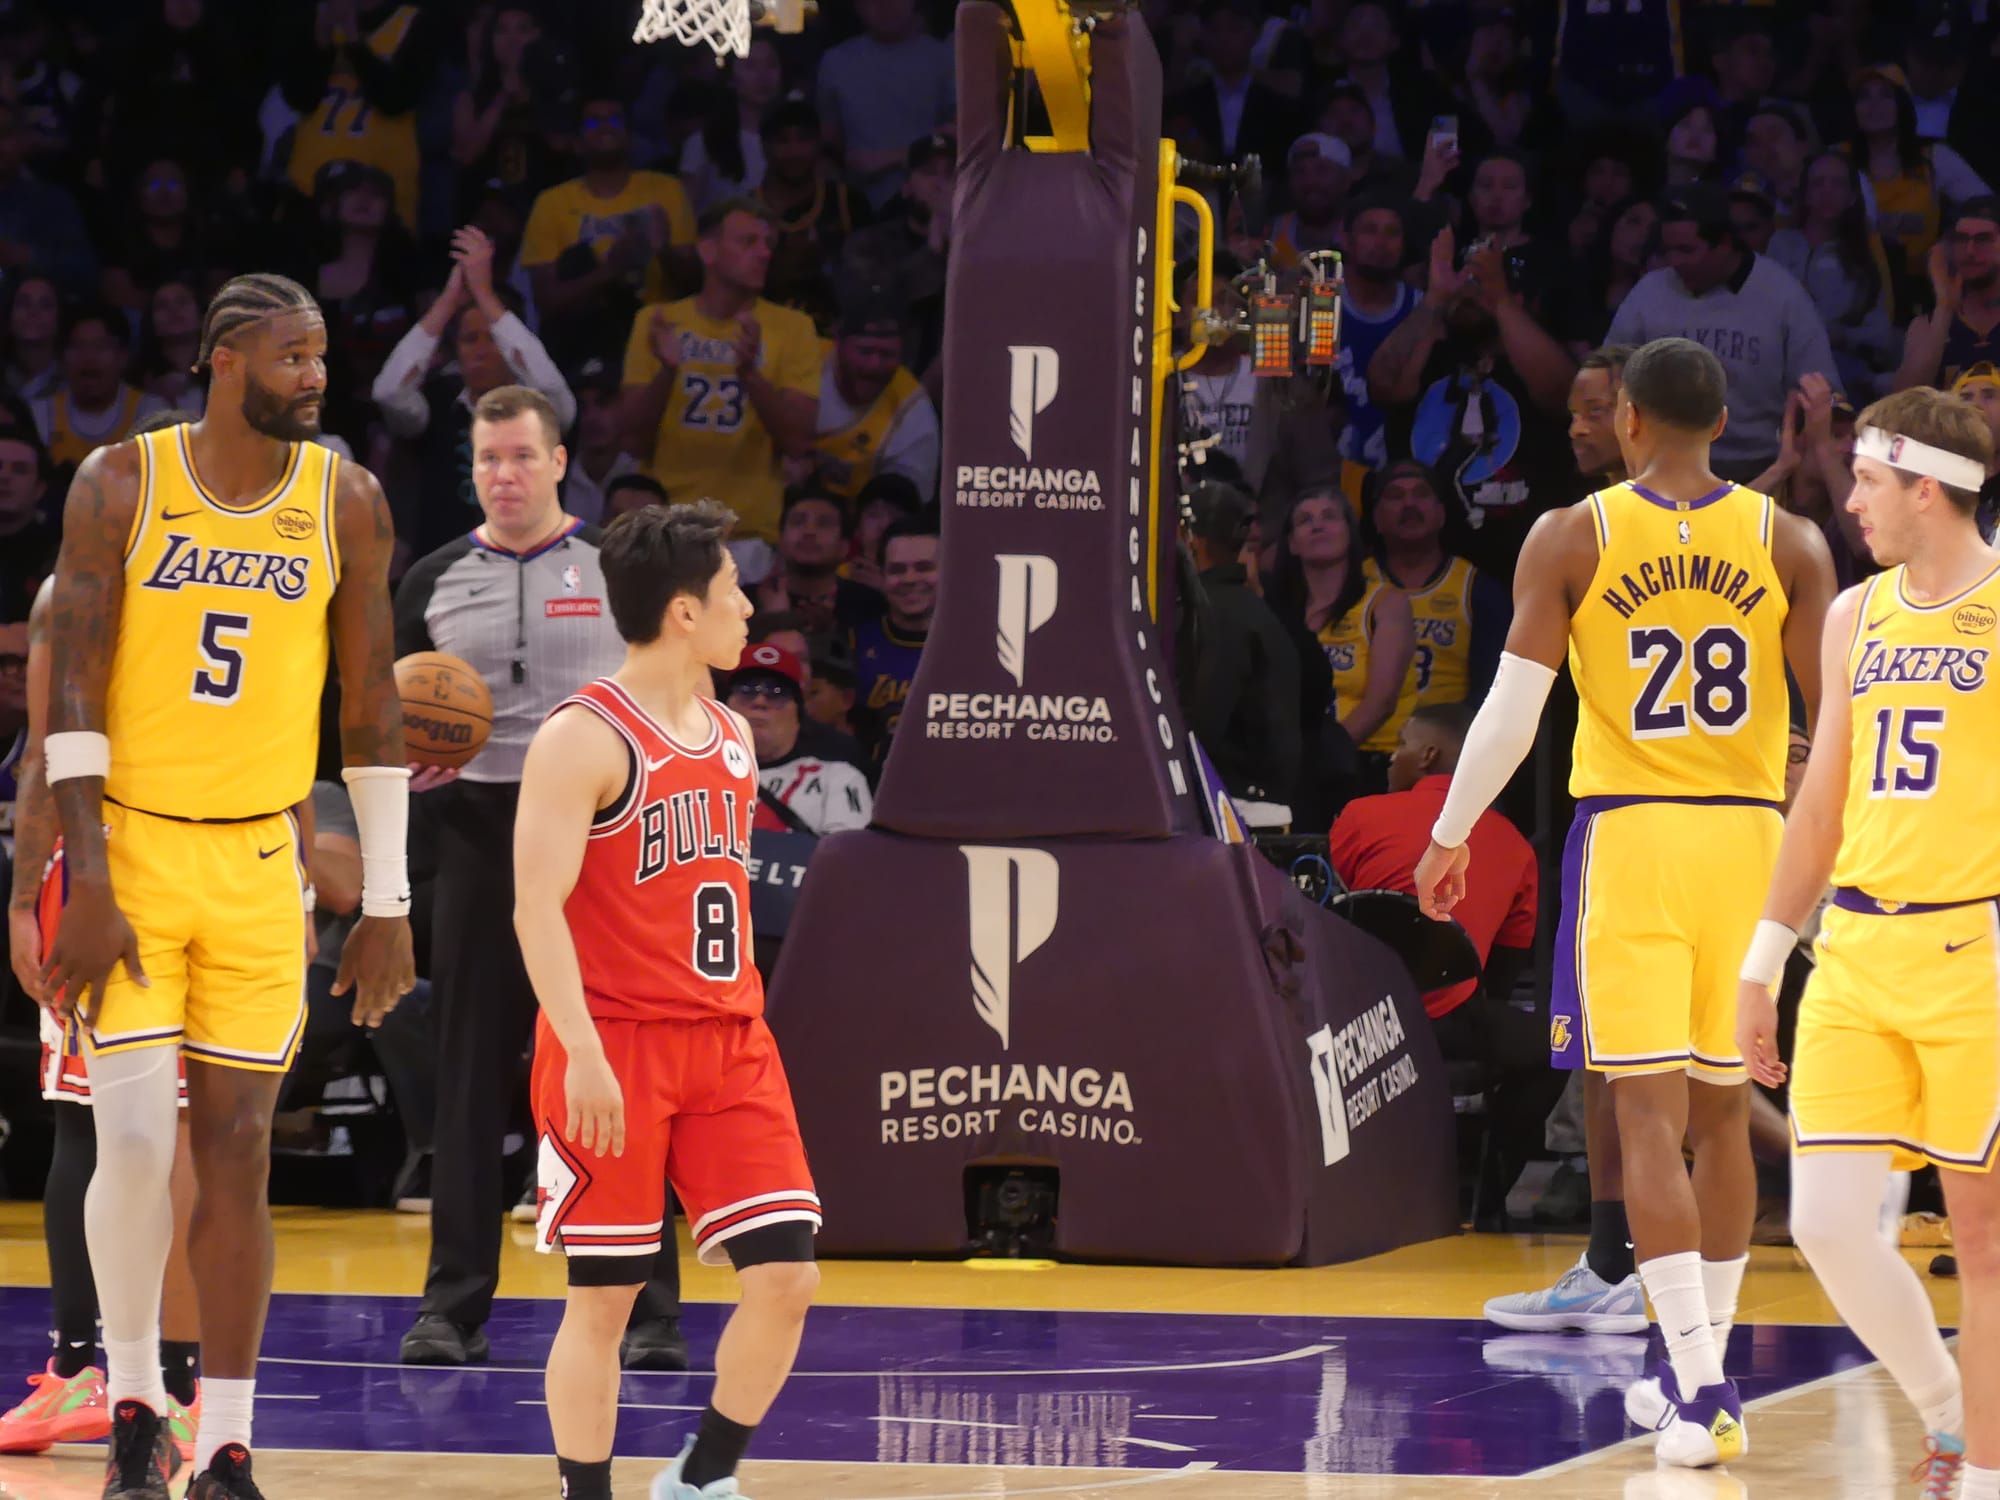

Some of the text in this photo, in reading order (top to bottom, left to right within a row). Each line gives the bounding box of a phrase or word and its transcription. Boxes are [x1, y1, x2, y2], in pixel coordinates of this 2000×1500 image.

[681, 373, 748, 434] 23
[955, 490, 1026, 508] RESORT
[956, 465, 1101, 494] PECHANGA
[141, 532, 311, 602] LAKERS
[1601, 554, 1768, 620] HACHIMURA
[1957, 611, 1994, 627] bibigo
[189, 609, 251, 708] 5
[1628, 624, 1750, 741] 28
[1852, 638, 1990, 697] LAKERS
[926, 721, 1016, 740] RESORT
[927, 693, 1112, 723] PECHANGA
[1868, 706, 1947, 800] 15
[748, 858, 807, 888] ELT
[693, 882, 740, 981] 8
[1333, 994, 1406, 1088] PECHANGA
[880, 1064, 1135, 1113] PECHANGA
[1346, 1077, 1382, 1131] RESORT
[881, 1108, 1001, 1145] RESORT
